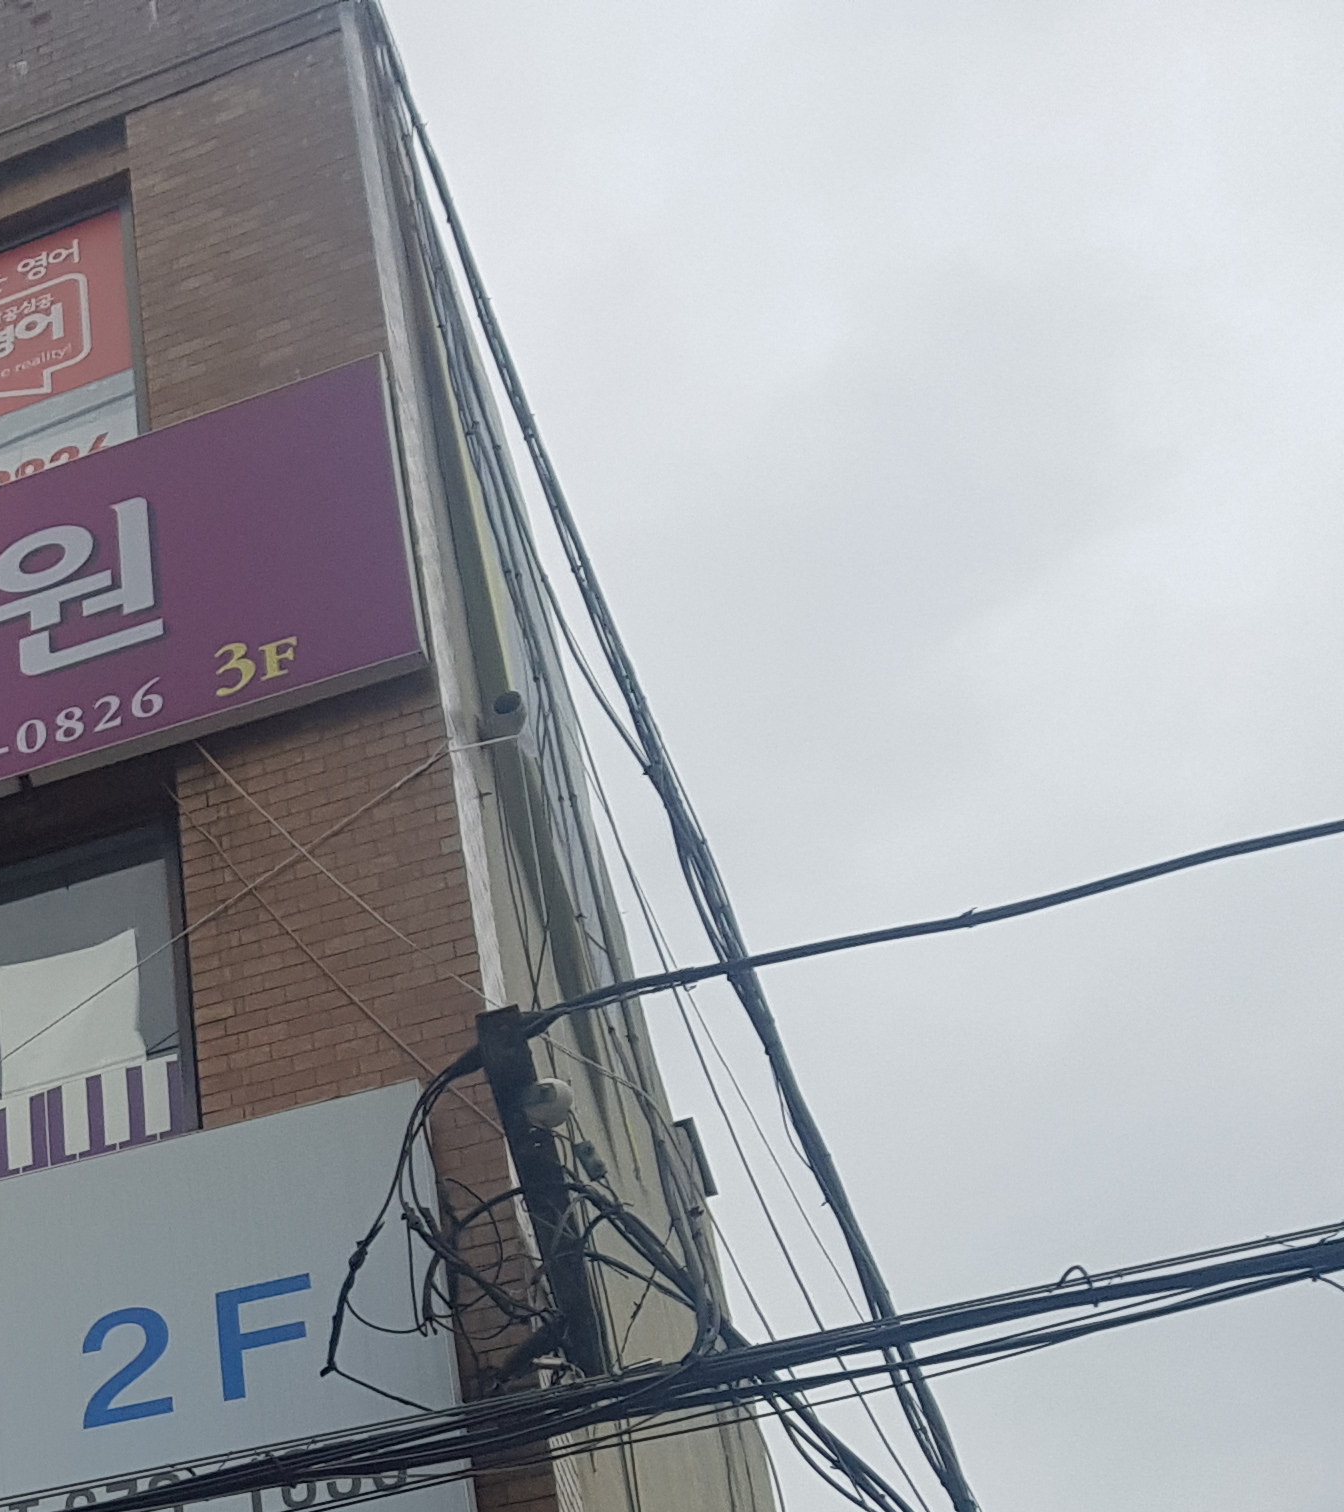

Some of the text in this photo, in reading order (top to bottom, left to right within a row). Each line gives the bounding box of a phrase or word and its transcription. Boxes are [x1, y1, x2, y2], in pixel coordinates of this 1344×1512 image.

[17, 239, 79, 280] 영어
[214, 636, 298, 697] 3F
[81, 1272, 312, 1431] 2F
